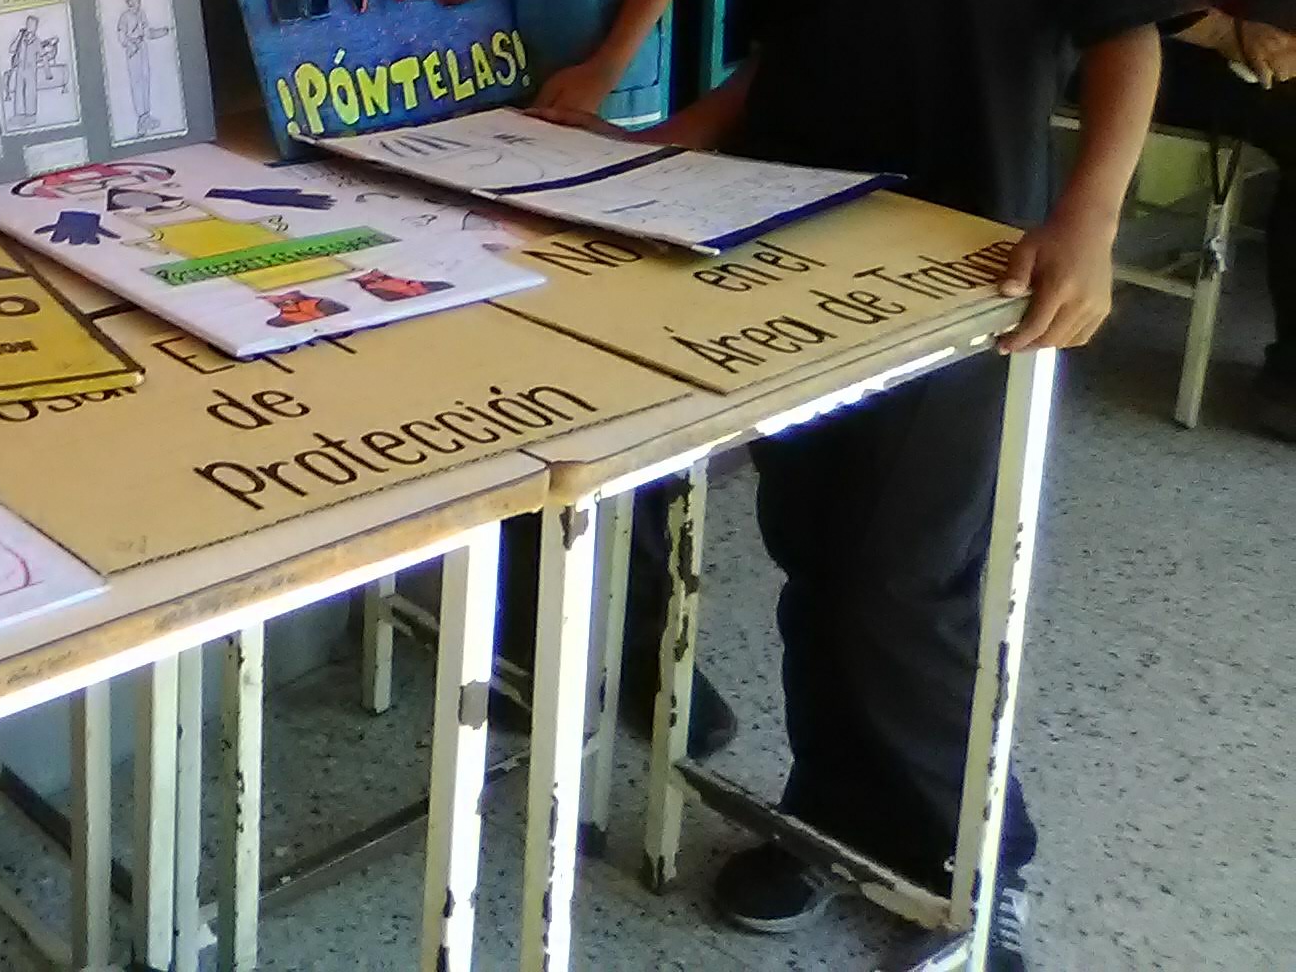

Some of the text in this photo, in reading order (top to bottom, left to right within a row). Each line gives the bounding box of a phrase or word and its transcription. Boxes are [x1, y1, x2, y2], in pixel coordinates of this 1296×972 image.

[521, 240, 643, 276] No
[692, 240, 827, 293] en el
[809, 289, 906, 325] de
[206, 388, 312, 430] de
